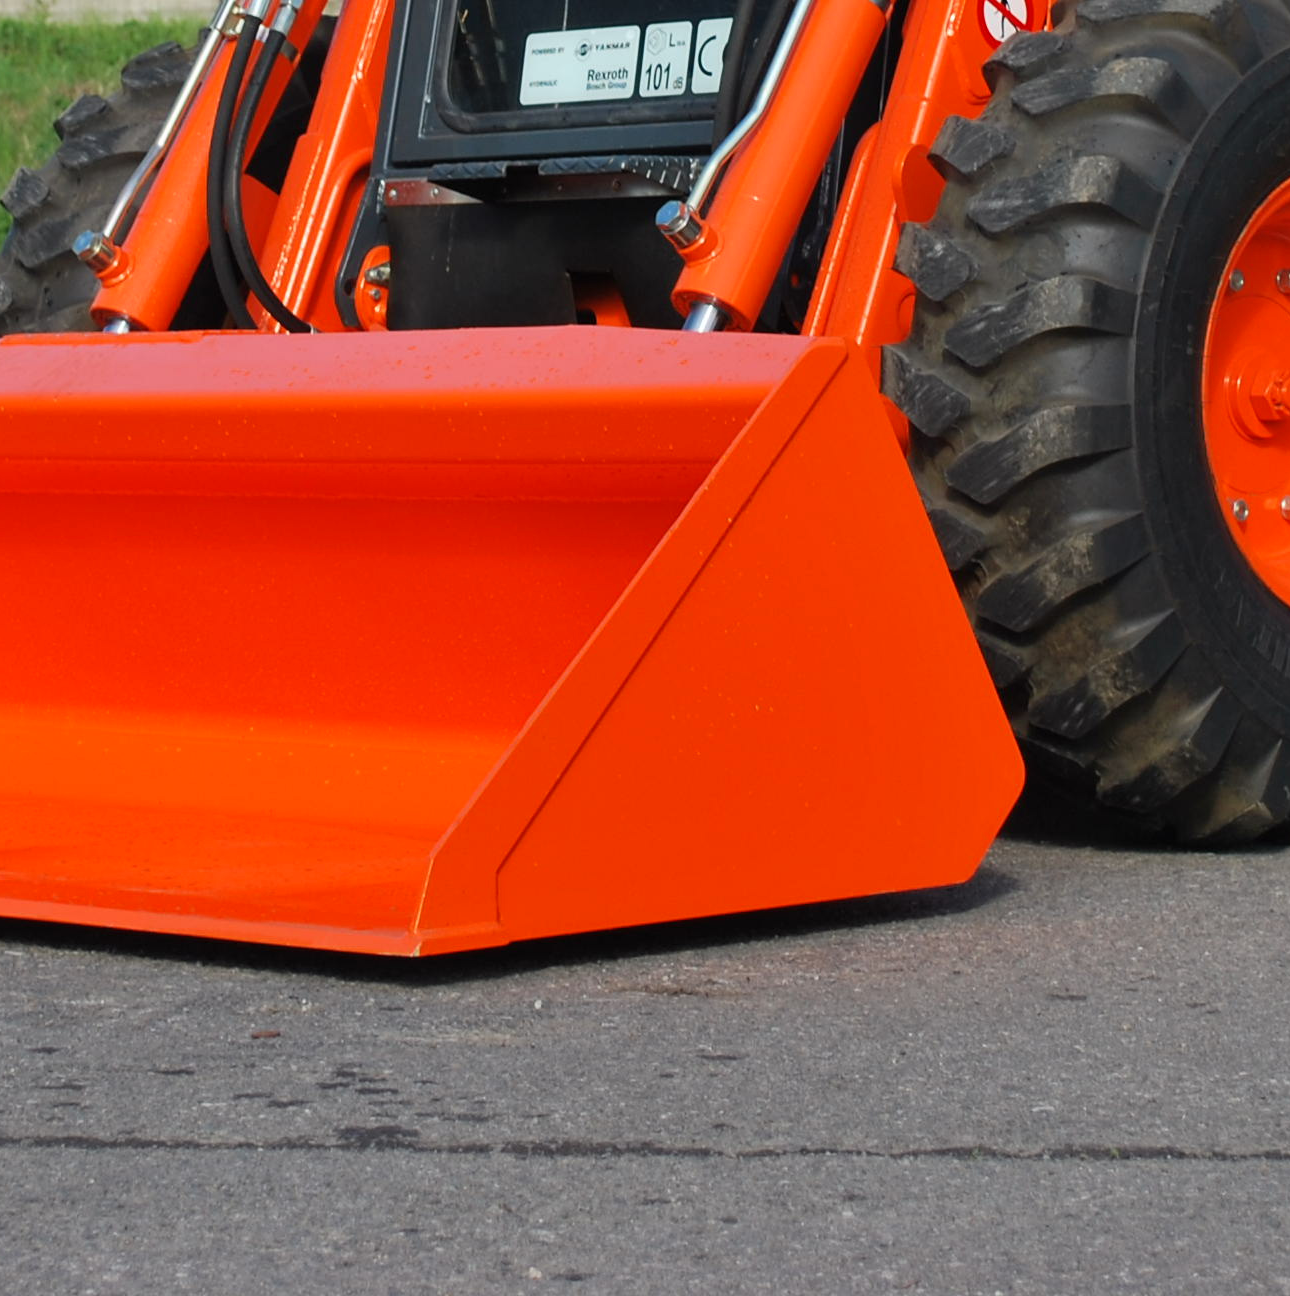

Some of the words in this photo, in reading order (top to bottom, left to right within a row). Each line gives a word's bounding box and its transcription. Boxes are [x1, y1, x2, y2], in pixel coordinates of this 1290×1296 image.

[588, 68, 628, 81] Rexroth
[645, 62, 671, 91] 101
[607, 81, 627, 90] Group
